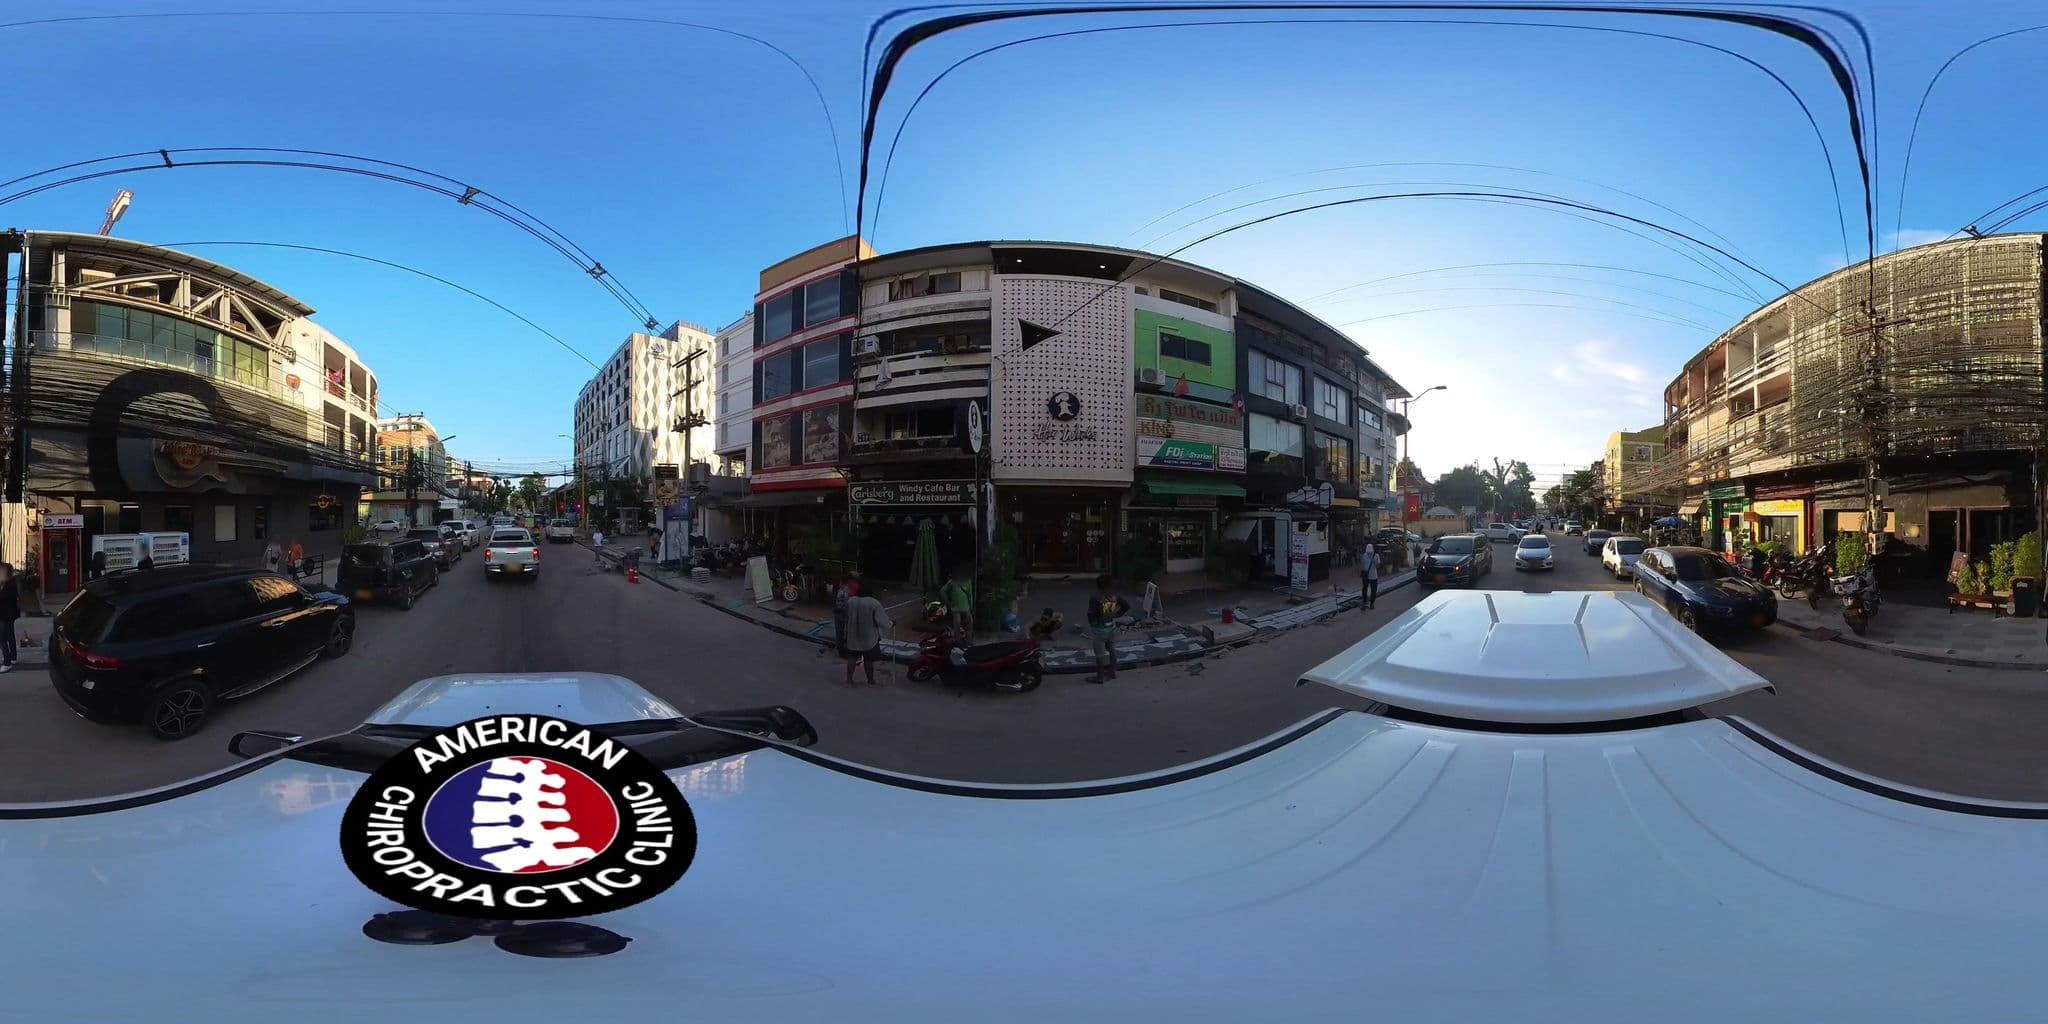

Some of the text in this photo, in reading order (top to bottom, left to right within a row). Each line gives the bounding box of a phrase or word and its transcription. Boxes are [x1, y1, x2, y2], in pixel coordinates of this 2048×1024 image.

[1165, 446, 1185, 457] FDi
[899, 483, 960, 493] Windy Cafe Bar
[851, 486, 894, 502] Carlsberg
[899, 493, 961, 502] and Restaurant
